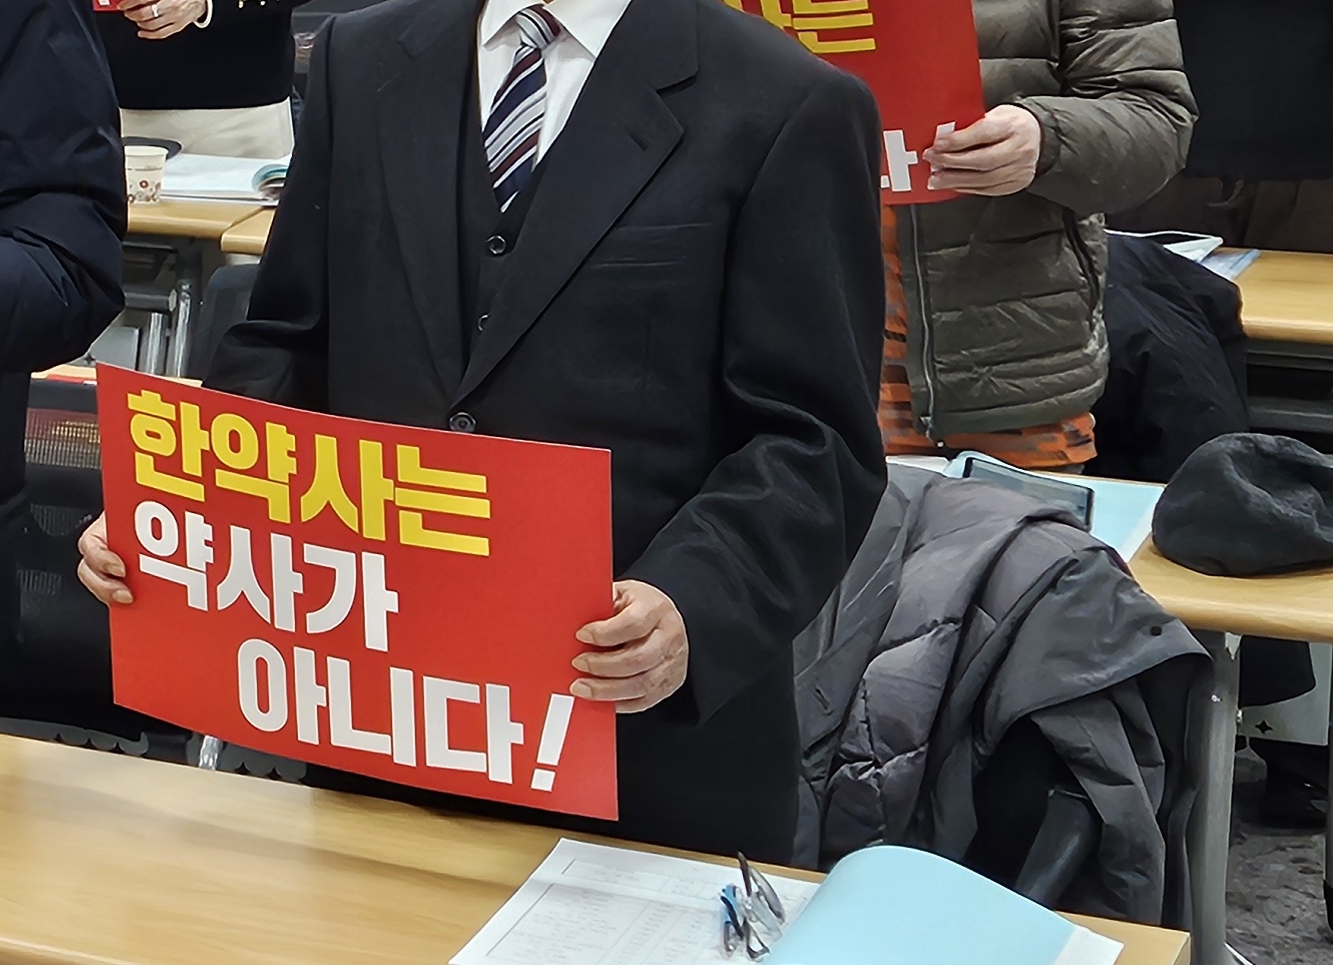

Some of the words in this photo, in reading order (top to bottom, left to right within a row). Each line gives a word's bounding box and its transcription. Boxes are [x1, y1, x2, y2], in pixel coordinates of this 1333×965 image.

[126, 387, 492, 558] 한약사는
[132, 499, 400, 653] 약사가
[236, 637, 576, 793] 아니다!
